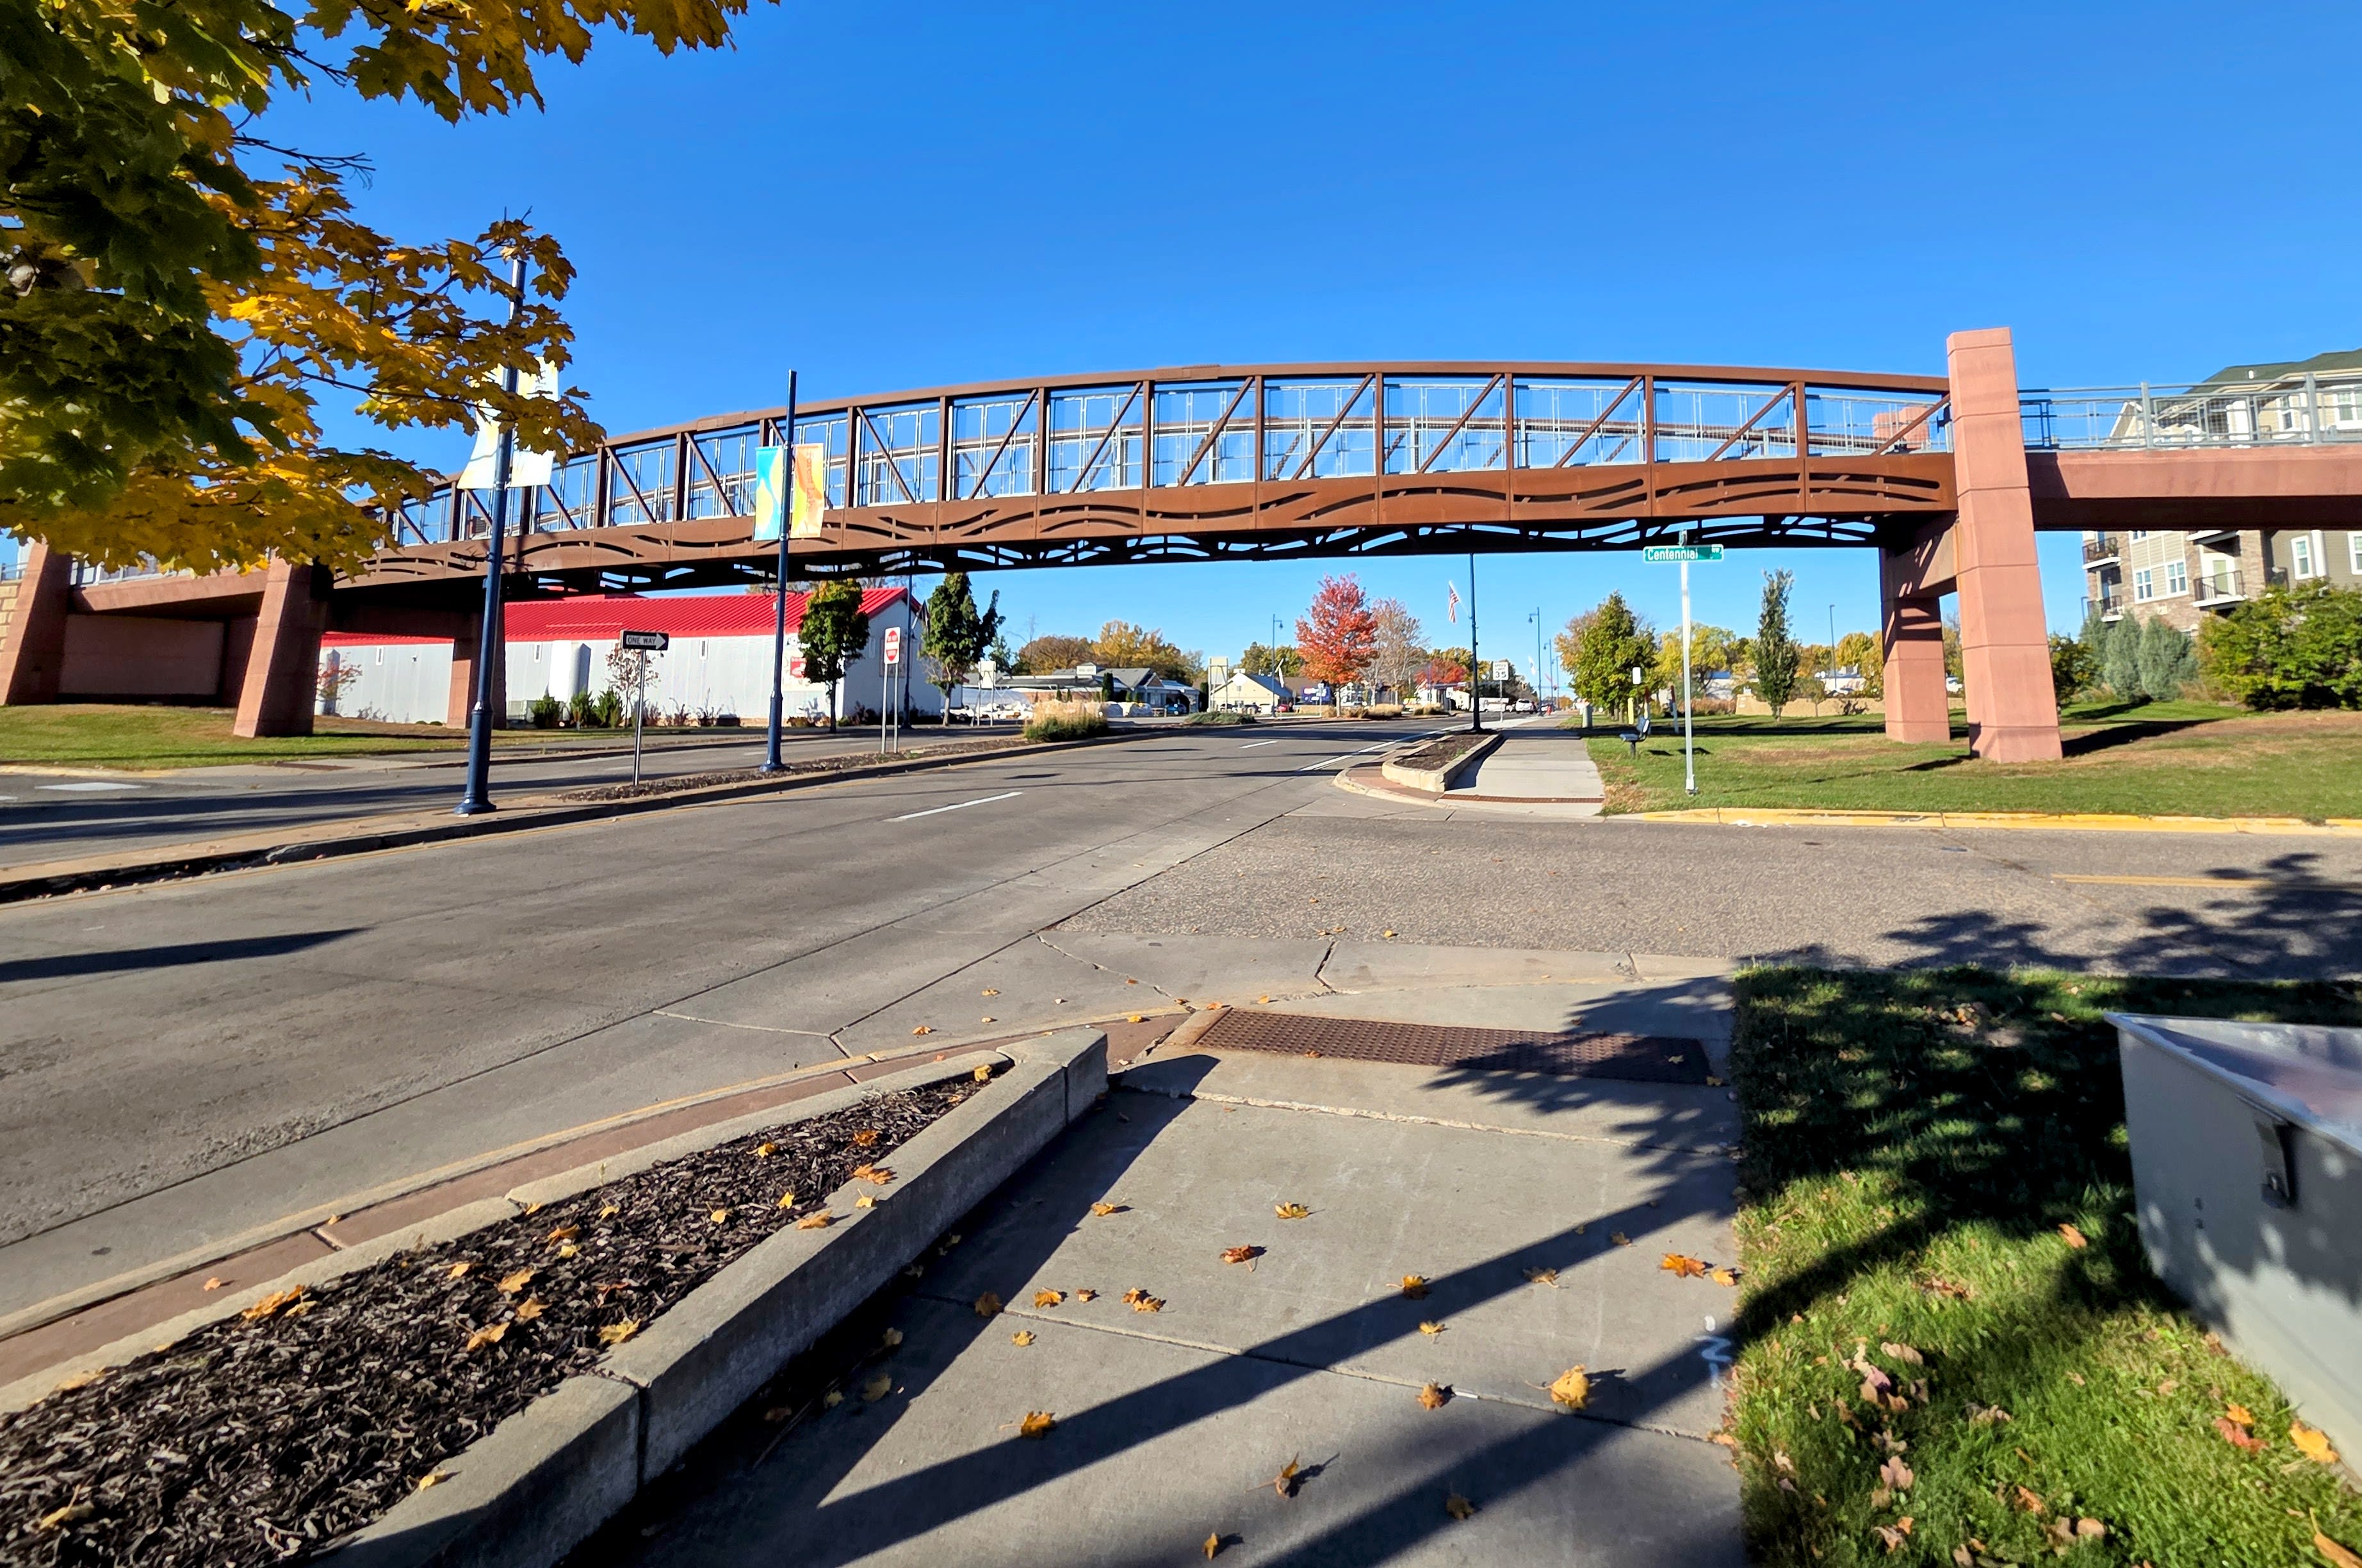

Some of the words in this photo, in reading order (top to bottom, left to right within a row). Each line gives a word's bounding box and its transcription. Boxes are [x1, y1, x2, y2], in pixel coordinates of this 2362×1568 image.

[806, 488, 815, 512] Lake
[1647, 547, 1698, 561] Centennial
[628, 636, 641, 644] ONE
[643, 636, 656, 645] WAY
